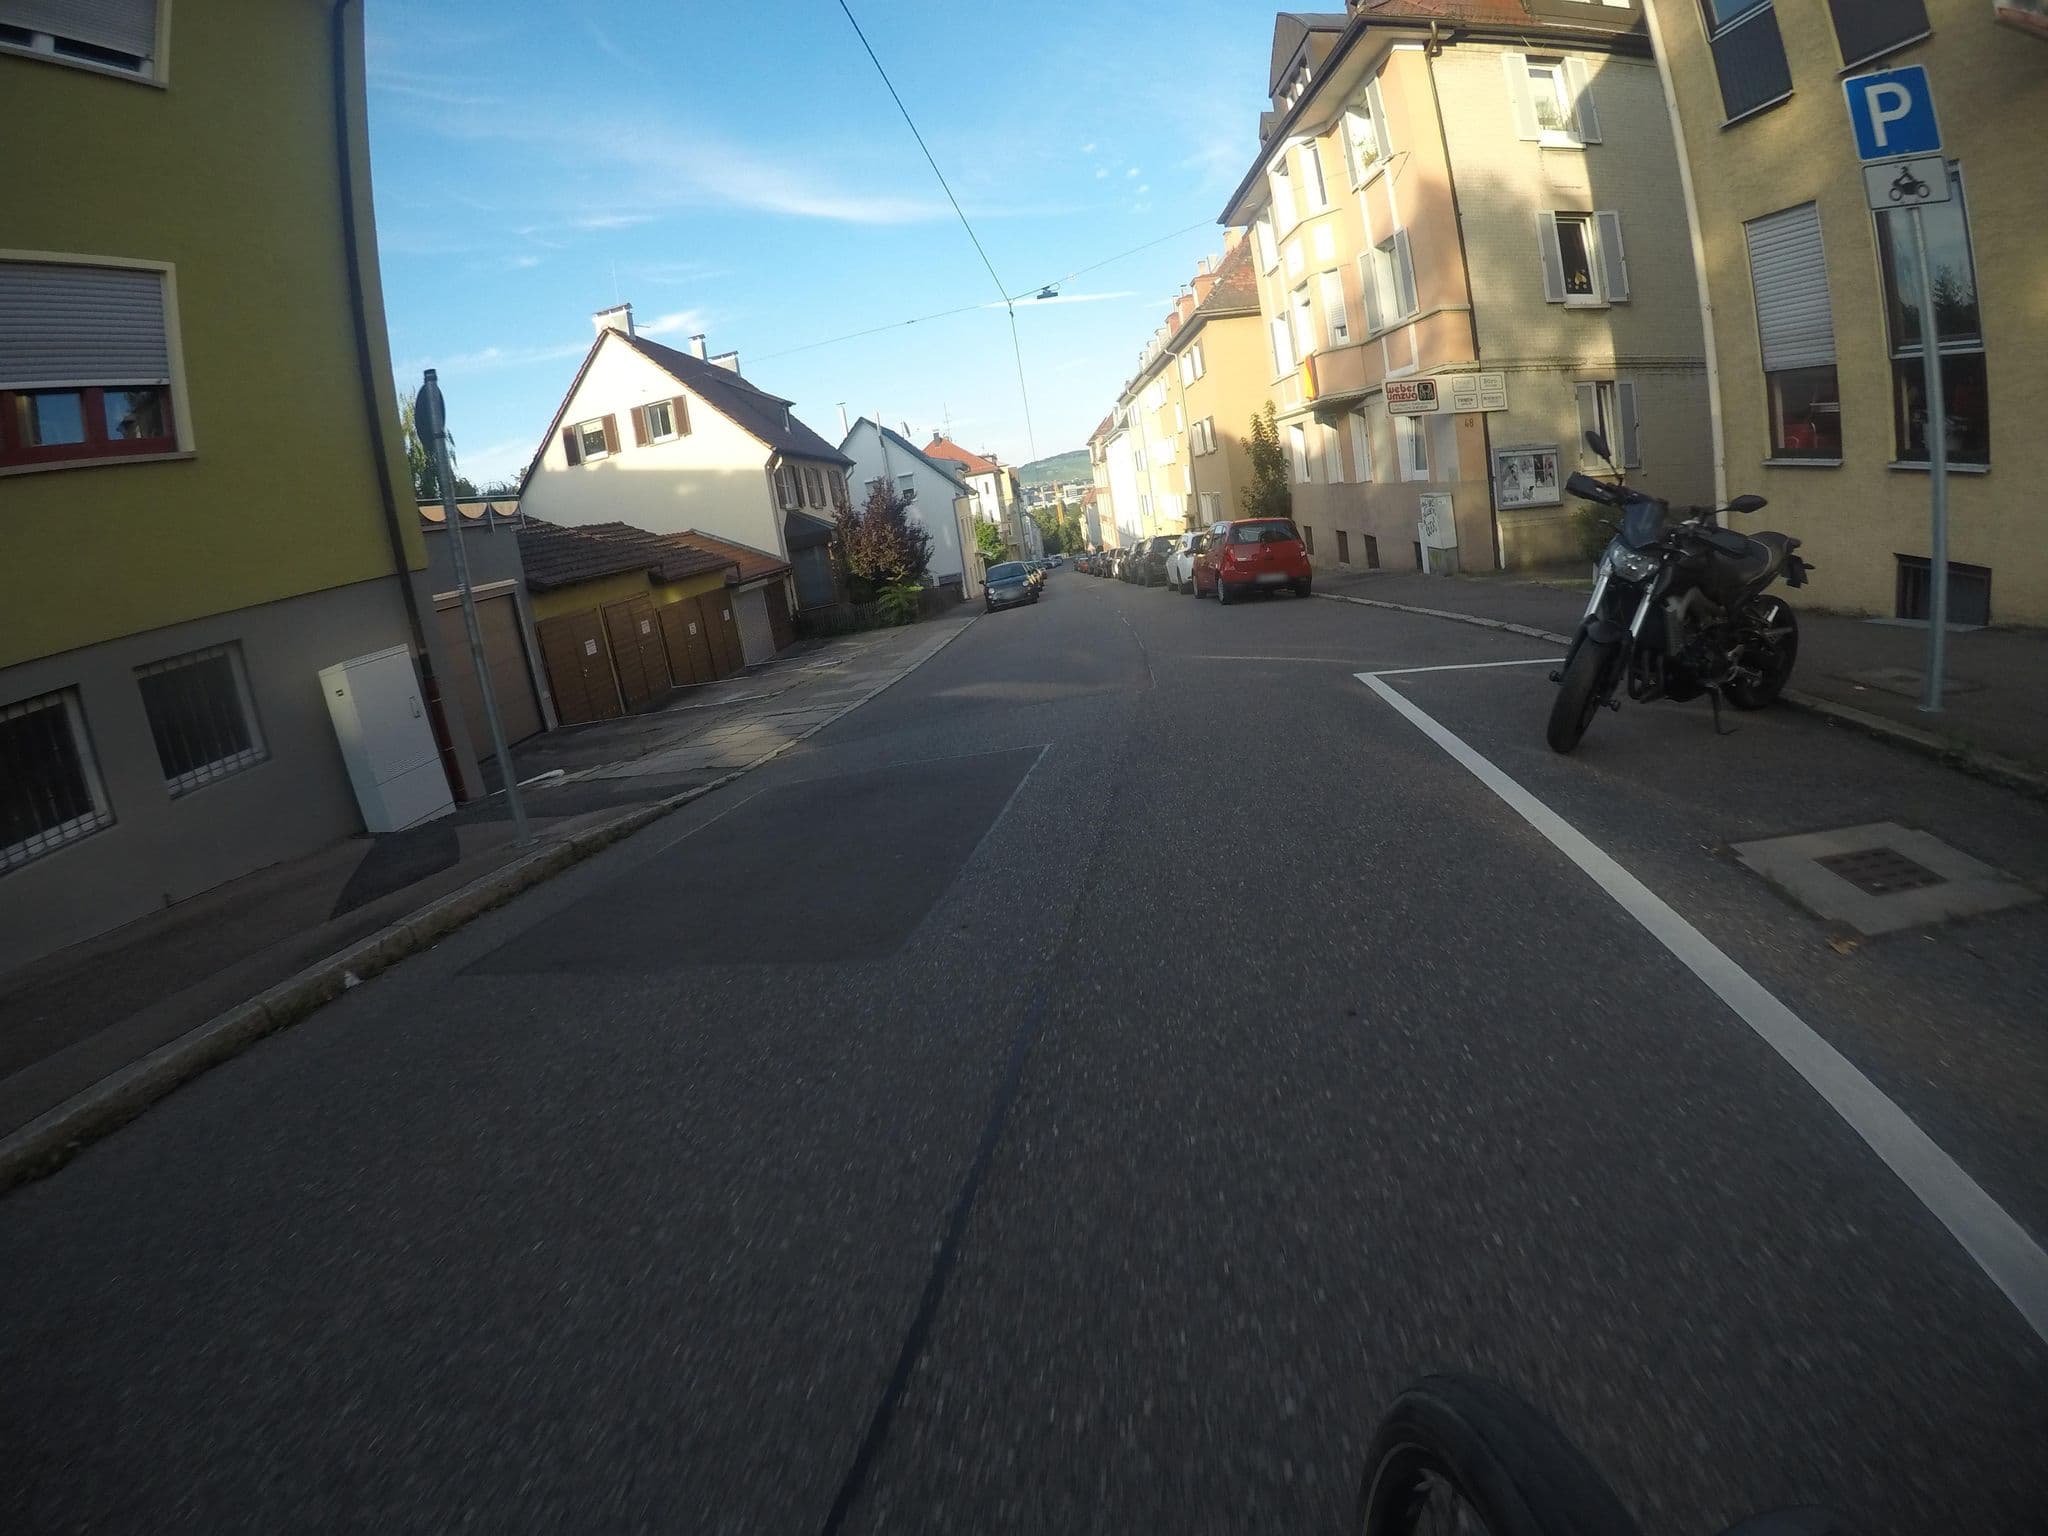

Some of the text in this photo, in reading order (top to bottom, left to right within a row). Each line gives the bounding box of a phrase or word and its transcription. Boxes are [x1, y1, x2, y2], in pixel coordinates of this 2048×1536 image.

[1864, 82, 1913, 147] P
[1387, 383, 1416, 393] weber
[1387, 392, 1418, 400] umzug
